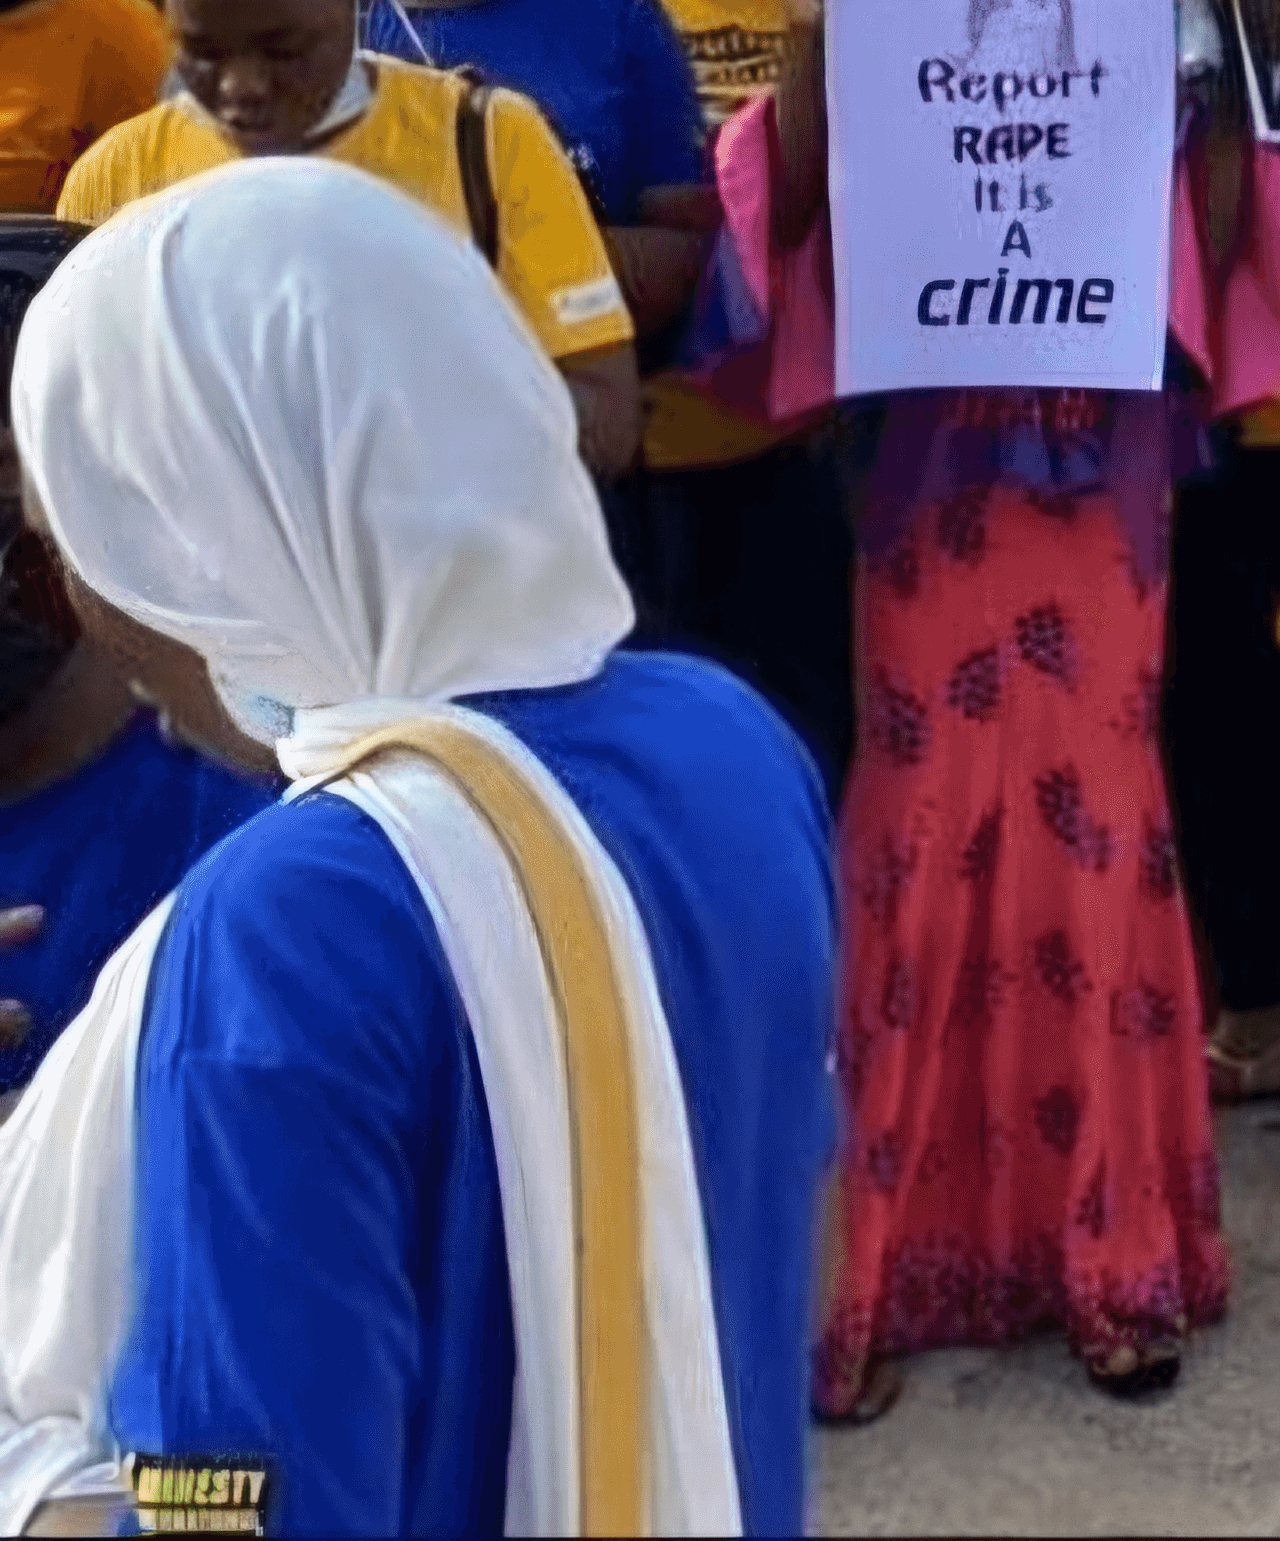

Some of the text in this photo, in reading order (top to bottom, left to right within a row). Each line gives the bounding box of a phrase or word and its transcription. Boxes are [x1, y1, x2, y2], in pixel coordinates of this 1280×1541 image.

[917, 58, 1107, 113] Report
[953, 122, 1072, 164] RAPE
[1000, 220, 1033, 258] A
[916, 268, 1115, 327] crime
